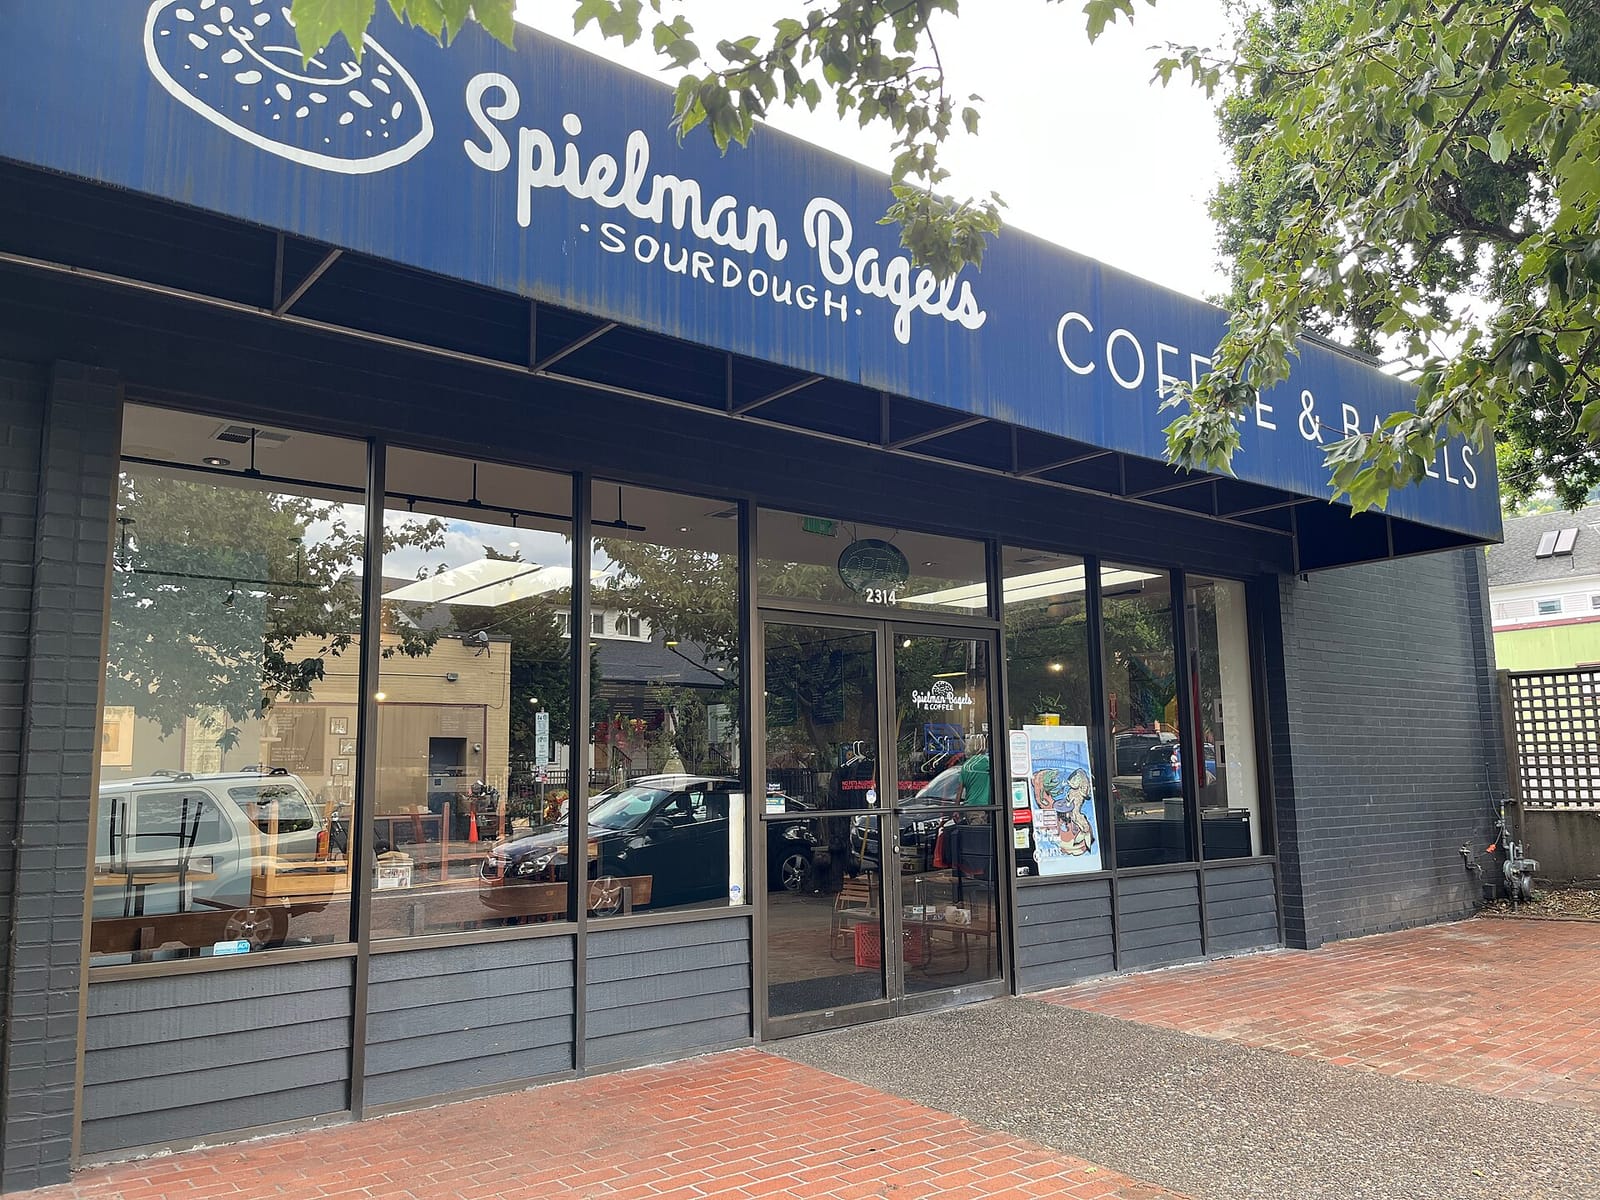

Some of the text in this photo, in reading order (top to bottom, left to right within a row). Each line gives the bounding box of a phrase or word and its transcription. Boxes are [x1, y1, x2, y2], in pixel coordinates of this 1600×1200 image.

[464, 73, 987, 345] Spielman Bagels
[599, 222, 849, 323] SOURDOUGH
[1056, 311, 1277, 431] COFFE
[1298, 389, 1324, 444] &
[865, 587, 897, 605] 2314
[912, 689, 973, 710] Spielman Bagels
[929, 703, 955, 711] COFFEE
